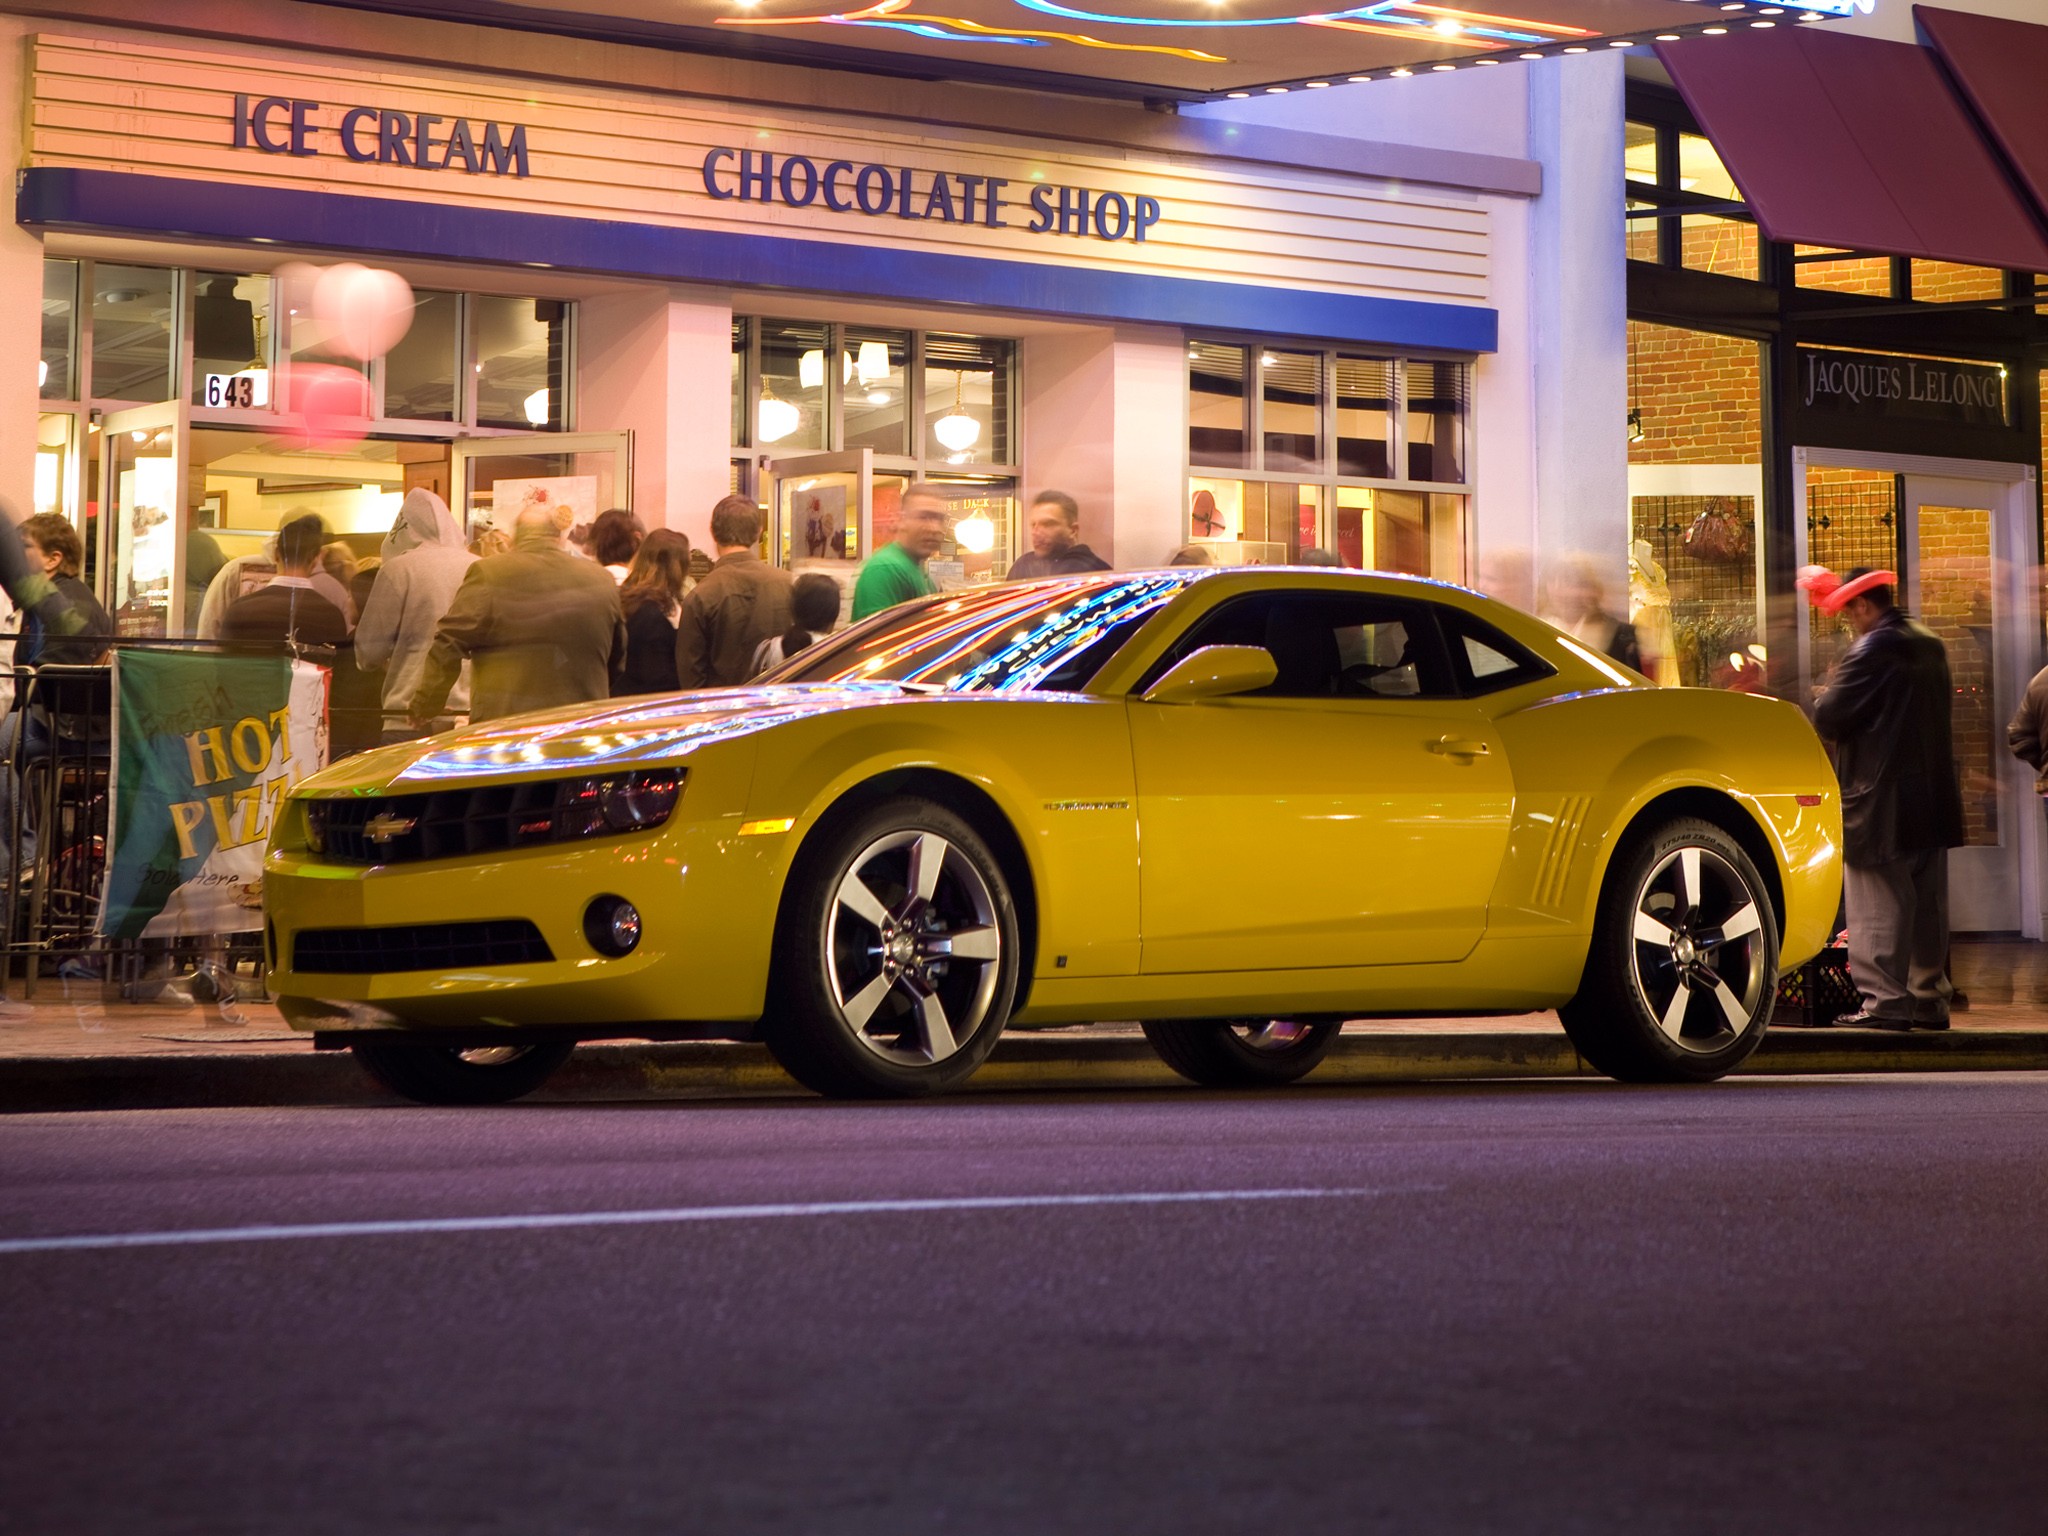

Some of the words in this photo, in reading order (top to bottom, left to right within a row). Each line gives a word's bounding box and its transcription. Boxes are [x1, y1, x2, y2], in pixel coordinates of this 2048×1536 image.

[235, 94, 319, 156] ICE
[341, 107, 530, 177] CREAM
[703, 148, 1008, 228] CHOCOLATE
[1029, 184, 1160, 243] SHOP
[208, 375, 254, 408] 643
[1804, 354, 1901, 406] JACQUES
[1908, 362, 1997, 408] LELONG
[183, 705, 293, 787] HOT
[169, 765, 296, 861] PIZZ
[187, 867, 240, 886] Here
